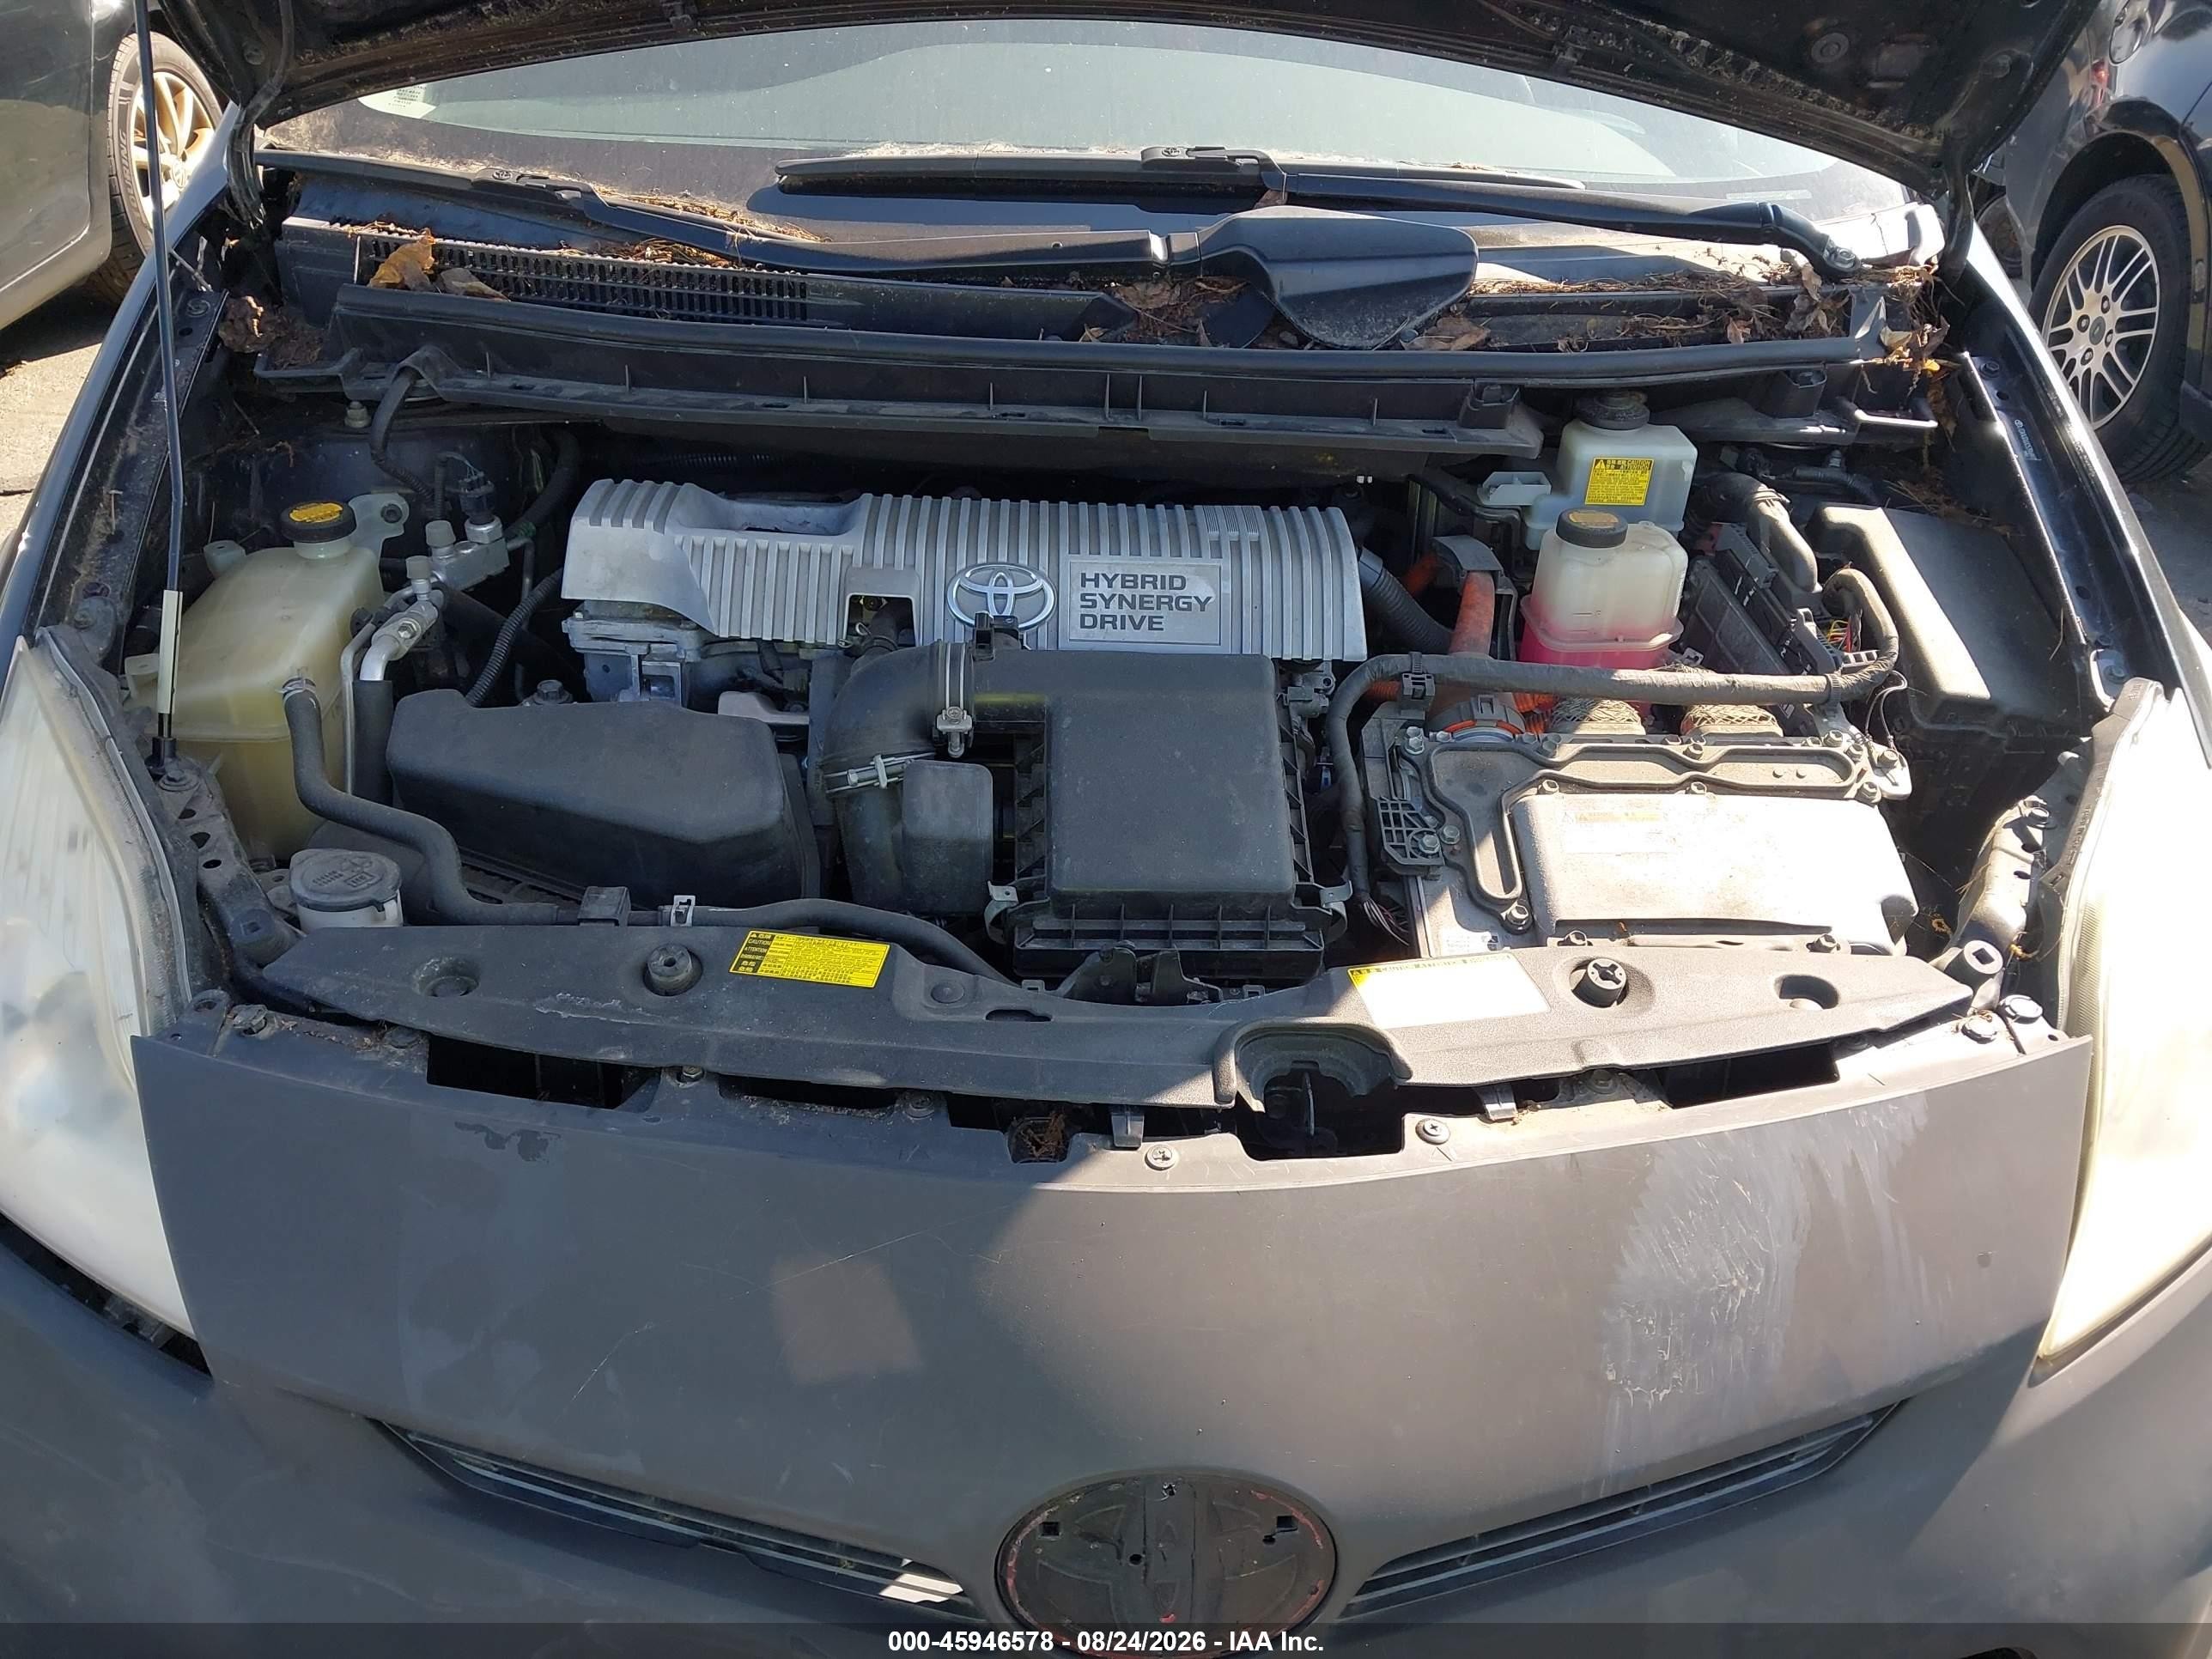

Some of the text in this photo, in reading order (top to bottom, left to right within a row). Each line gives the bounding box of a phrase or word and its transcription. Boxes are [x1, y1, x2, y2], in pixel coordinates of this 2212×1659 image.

[1080, 572, 1187, 591] HYBRID
[1079, 592, 1213, 611] SYNERGY
[1079, 614, 1164, 631] DRIVE
